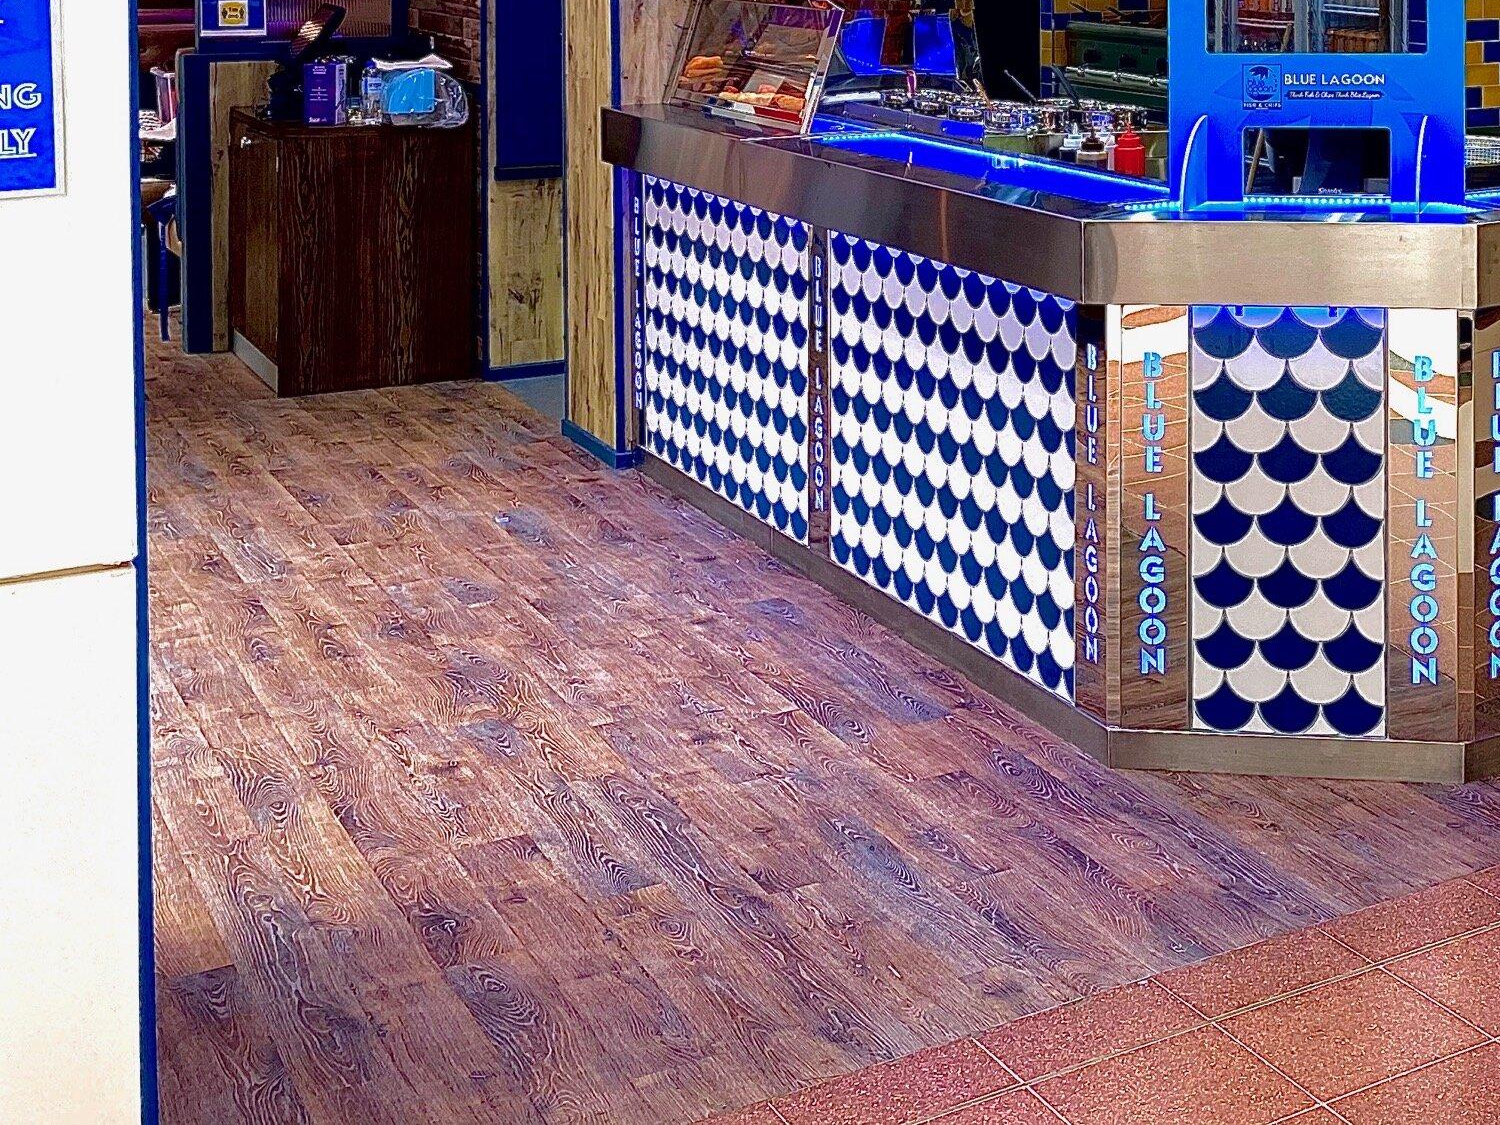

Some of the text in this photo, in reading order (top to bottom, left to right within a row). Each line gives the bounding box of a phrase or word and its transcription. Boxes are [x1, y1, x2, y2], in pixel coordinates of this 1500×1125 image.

[1284, 73, 1385, 85] BLUE LAGOON
[813, 255, 825, 512] BLUE LAGOON
[1083, 343, 1100, 665] BLUE LAGOON
[1138, 351, 1167, 675] BLUE LAGOON
[1409, 355, 1439, 686] BLUE LAGOON
